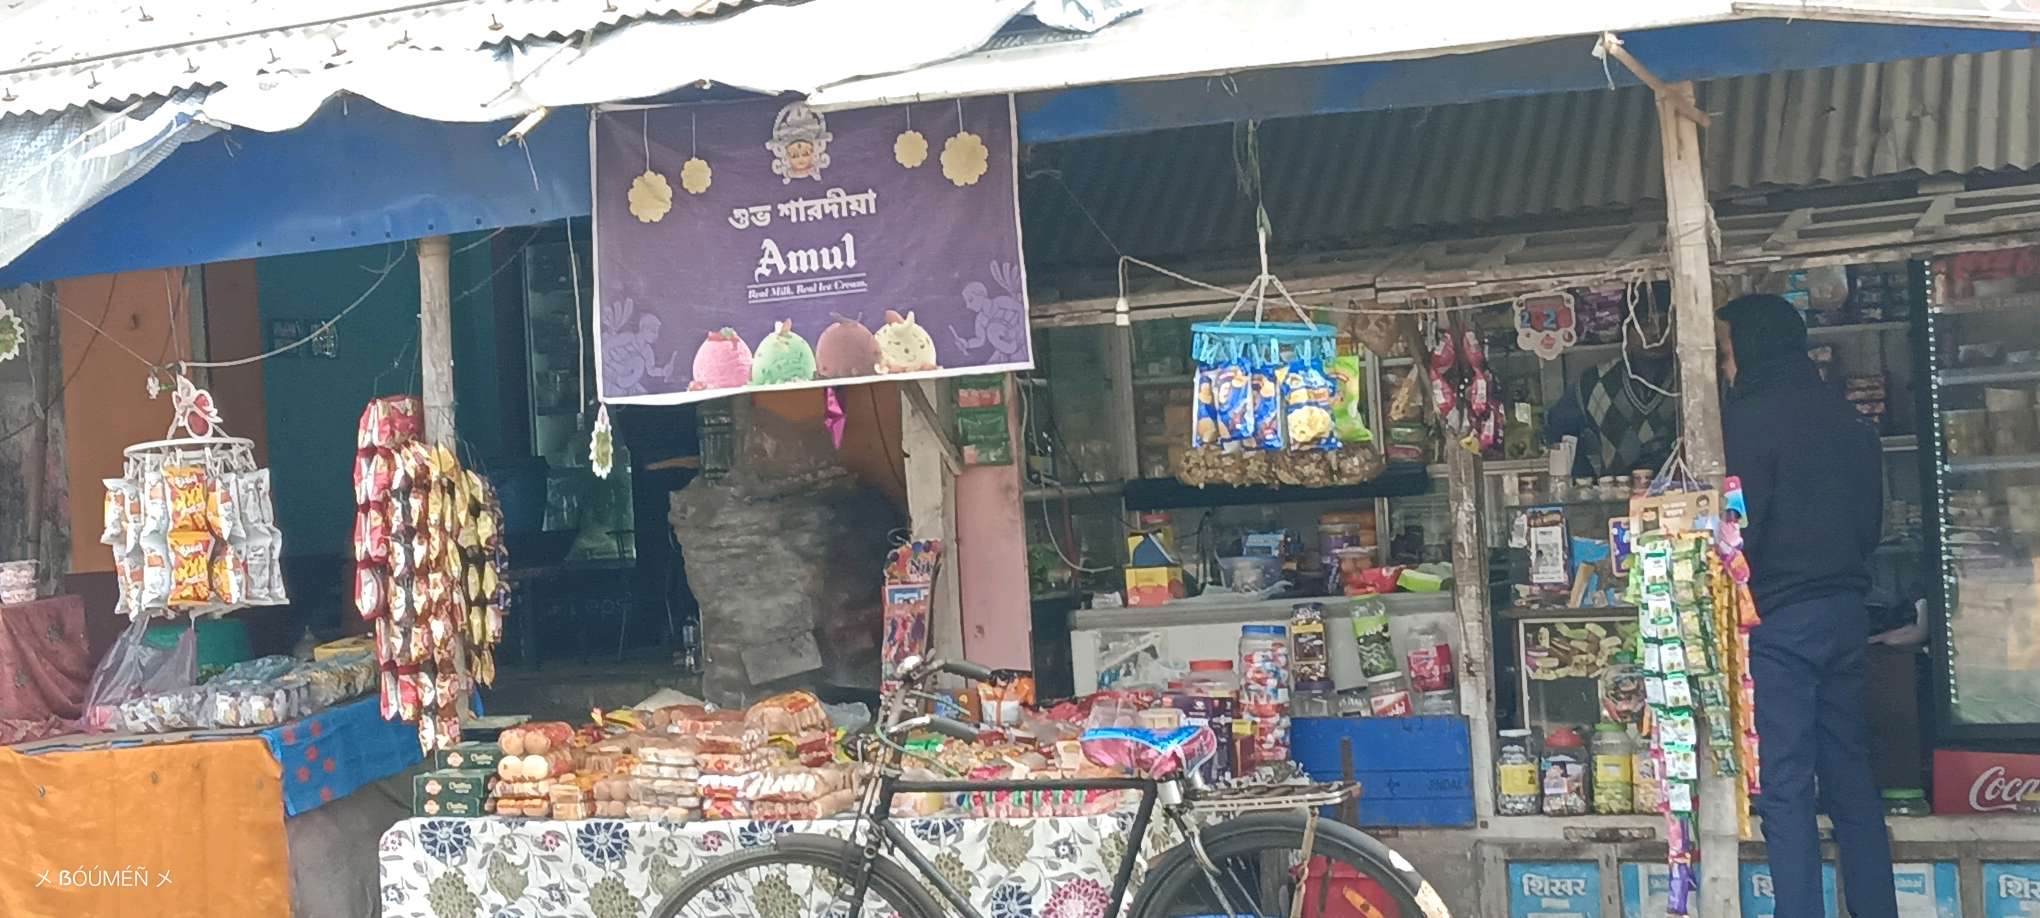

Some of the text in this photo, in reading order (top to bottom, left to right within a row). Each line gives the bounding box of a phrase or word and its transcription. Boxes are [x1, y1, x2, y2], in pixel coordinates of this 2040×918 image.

[728, 187, 877, 230] শুভ শারদীয়া
[754, 232, 857, 282] Amul
[748, 288, 769, 299] Real
[796, 283, 818, 295] Real
[1522, 873, 1587, 897] शिखर
